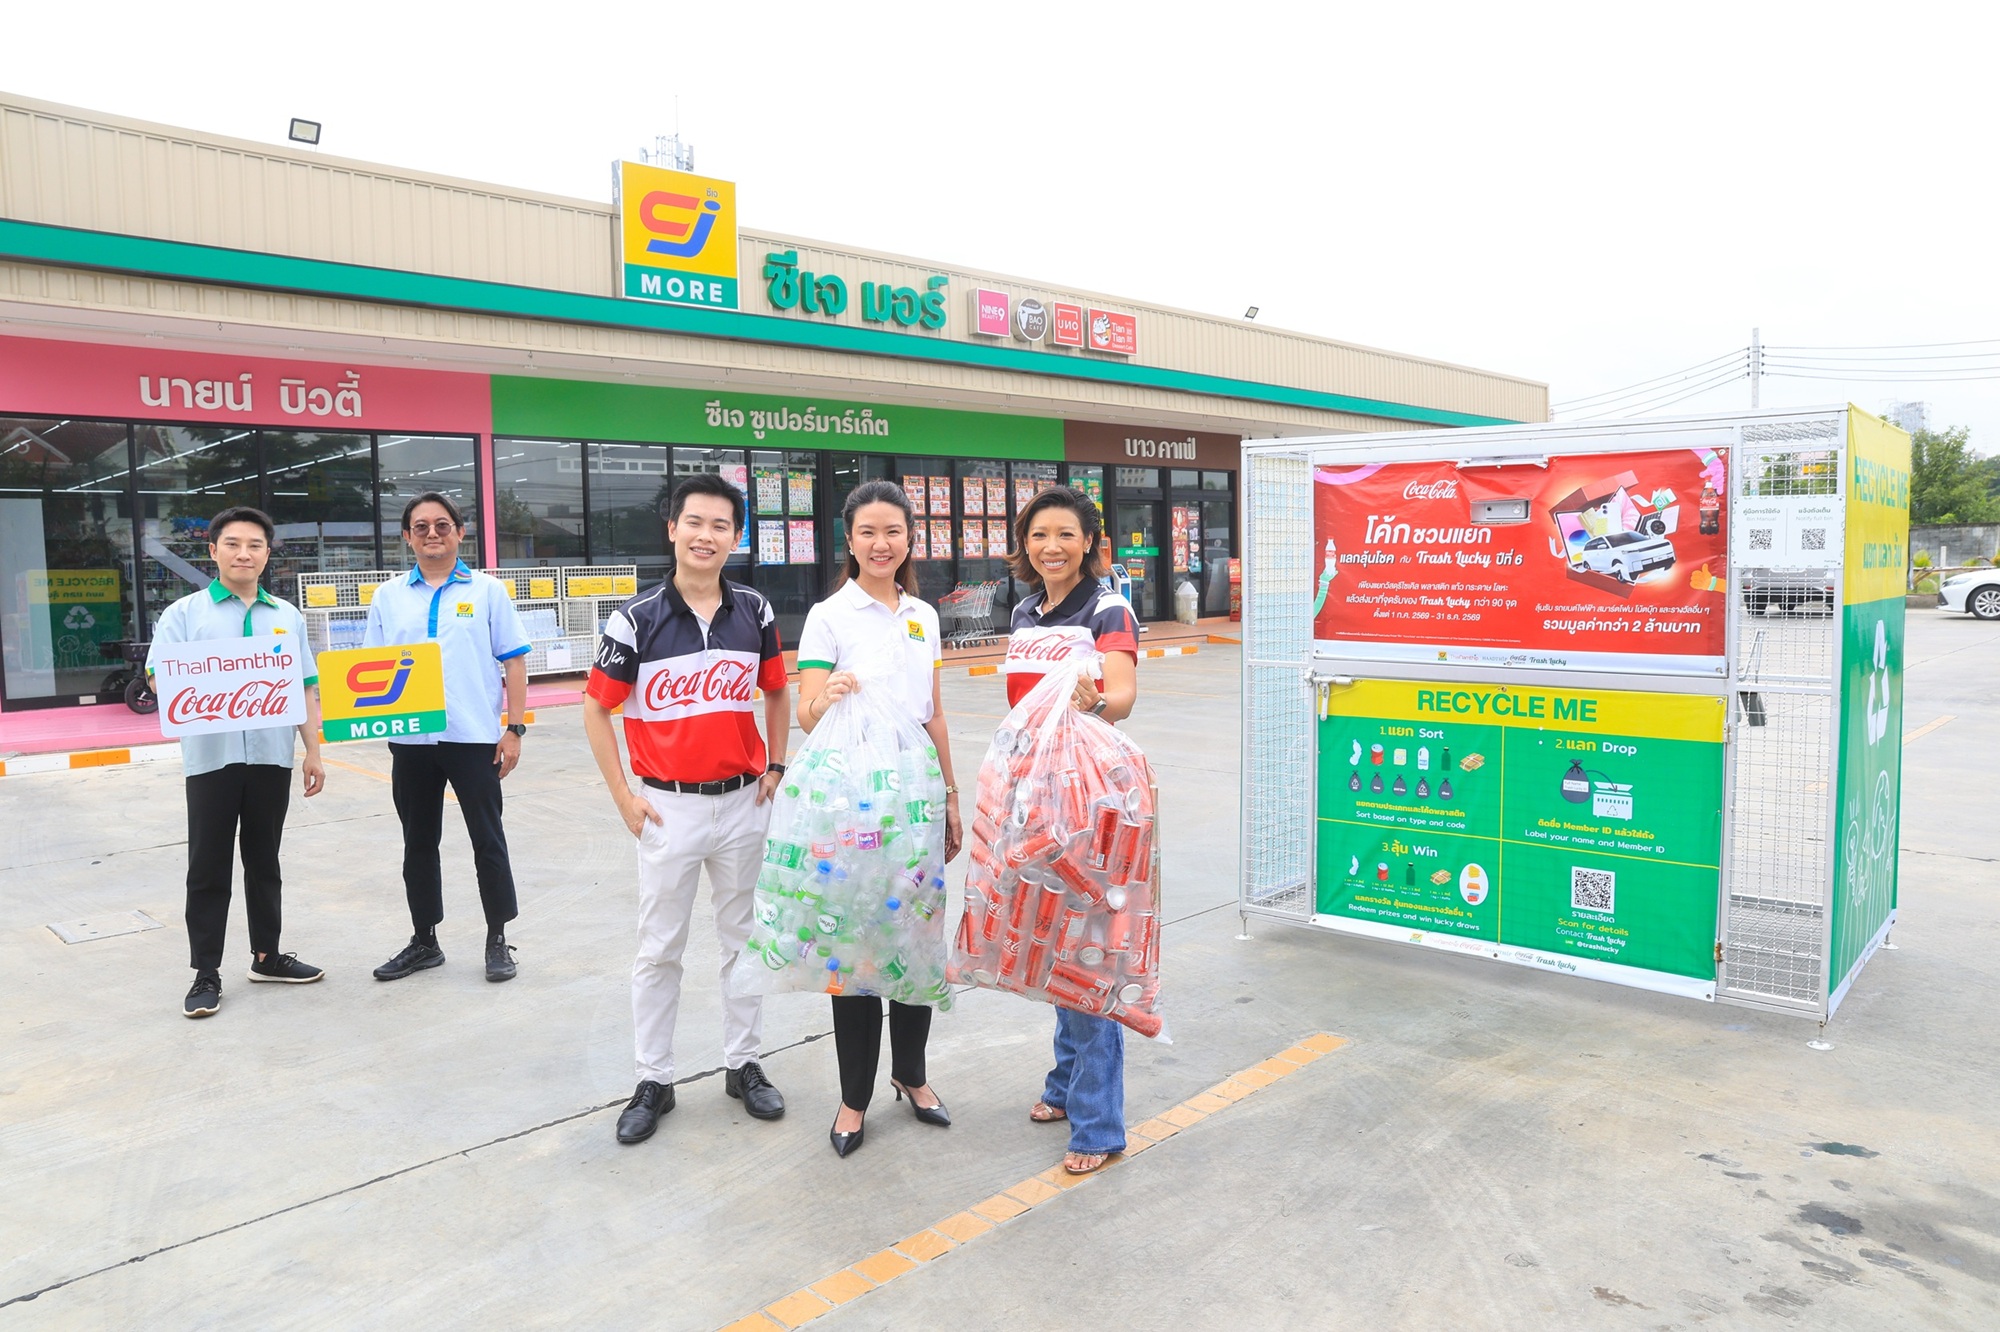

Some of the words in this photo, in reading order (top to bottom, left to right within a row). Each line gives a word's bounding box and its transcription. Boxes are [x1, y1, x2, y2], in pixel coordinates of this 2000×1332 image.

[641, 273, 722, 303] MORE
[763, 250, 848, 315] ซีเจ
[861, 275, 949, 330] มอร์
[1029, 315, 1043, 326] BAO
[1111, 322, 1125, 333] Tian
[1112, 332, 1126, 343] Tian
[139, 373, 252, 412] นายน์
[280, 370, 362, 417] บิวตี้
[705, 400, 745, 428] ซีเจ
[750, 407, 889, 440] ซูเปอร์มาร์เก็ต
[1125, 438, 1156, 458] บาว
[1158, 437, 1197, 461] คาเฟ่
[1403, 479, 1459, 499] Coca-Cola
[1854, 456, 1896, 507] RECYCLE
[1897, 470, 1908, 510] ME
[1365, 515, 1410, 544] โค้ก
[1413, 526, 1491, 544] ชวนแยก
[1340, 551, 1394, 569] แลกลุ้นโชค
[1400, 555, 1412, 564] กับ
[1416, 551, 1452, 565] Trash
[1455, 551, 1491, 568] Lucky
[1496, 548, 1515, 565] ปีที่
[1515, 554, 1524, 565] 6
[1421, 582, 1450, 591] พลาสติก
[1451, 582, 1464, 590] แก้ว
[1465, 583, 1492, 591] กระดาษ
[1493, 582, 1508, 591] โลหะ
[1346, 592, 1417, 606] แล้วส่งมาที่จุดรับของ
[1419, 595, 1444, 605] Trash
[1446, 596, 1471, 608] Lucky
[1474, 597, 1490, 606] กว่า
[1492, 598, 1503, 607] 90
[1505, 599, 1517, 610] จุด
[1535, 603, 1553, 613] ลุ้นรับ
[1554, 603, 1596, 612] รถยนต์ไฟฟ้า
[1373, 608, 1390, 618] ตั้งแต่
[1543, 617, 1629, 635] รวมมูลค่ากว่า
[1632, 620, 1642, 632] 2
[1644, 618, 1701, 633] ล้านบาท
[645, 659, 757, 711] Coca-Cola
[167, 678, 294, 725] Coca-Cola
[1418, 690, 1545, 718] RECYCLE
[1553, 698, 1597, 722] ME
[350, 718, 421, 738] MORE
[1418, 728, 1444, 740] Sort
[1602, 741, 1637, 757] Drop
[1356, 811, 1371, 819] Sort
[1373, 812, 1395, 821] based
[1409, 816, 1426, 825] type
[1429, 819, 1443, 827] and
[1446, 820, 1466, 829] code
[1537, 817, 1561, 829] ติดชื่อ
[1563, 822, 1599, 833] Member
[1602, 827, 1612, 835] ID
[1614, 828, 1655, 840] แล้วใส่ถัง
[1413, 844, 1438, 857] Win
[1525, 829, 1547, 838] Label
[1550, 833, 1569, 842] your
[1572, 836, 1595, 845] name
[1598, 839, 1614, 848] and
[1617, 841, 1653, 853] Member
[1656, 846, 1665, 854] ID
[1355, 893, 1391, 906] แลกรางวัล
[1349, 903, 1377, 914] Redeem
[1379, 908, 1401, 918] prizes
[1403, 912, 1417, 921] and
[1434, 917, 1454, 927] lucky
[1457, 921, 1480, 931] draws
[1572, 910, 1615, 923] รายละเอียด
[1558, 918, 1579, 928] Scan
[1582, 922, 1596, 930] for
[1599, 925, 1629, 936] details
[1556, 927, 1584, 938] Contact
[1586, 932, 1606, 942] Trash
[1607, 936, 1627, 947] Lucky
[1577, 941, 1619, 954] @trashlucky
[1536, 956, 1555, 966] Trash
[1556, 960, 1577, 971] Lucky
